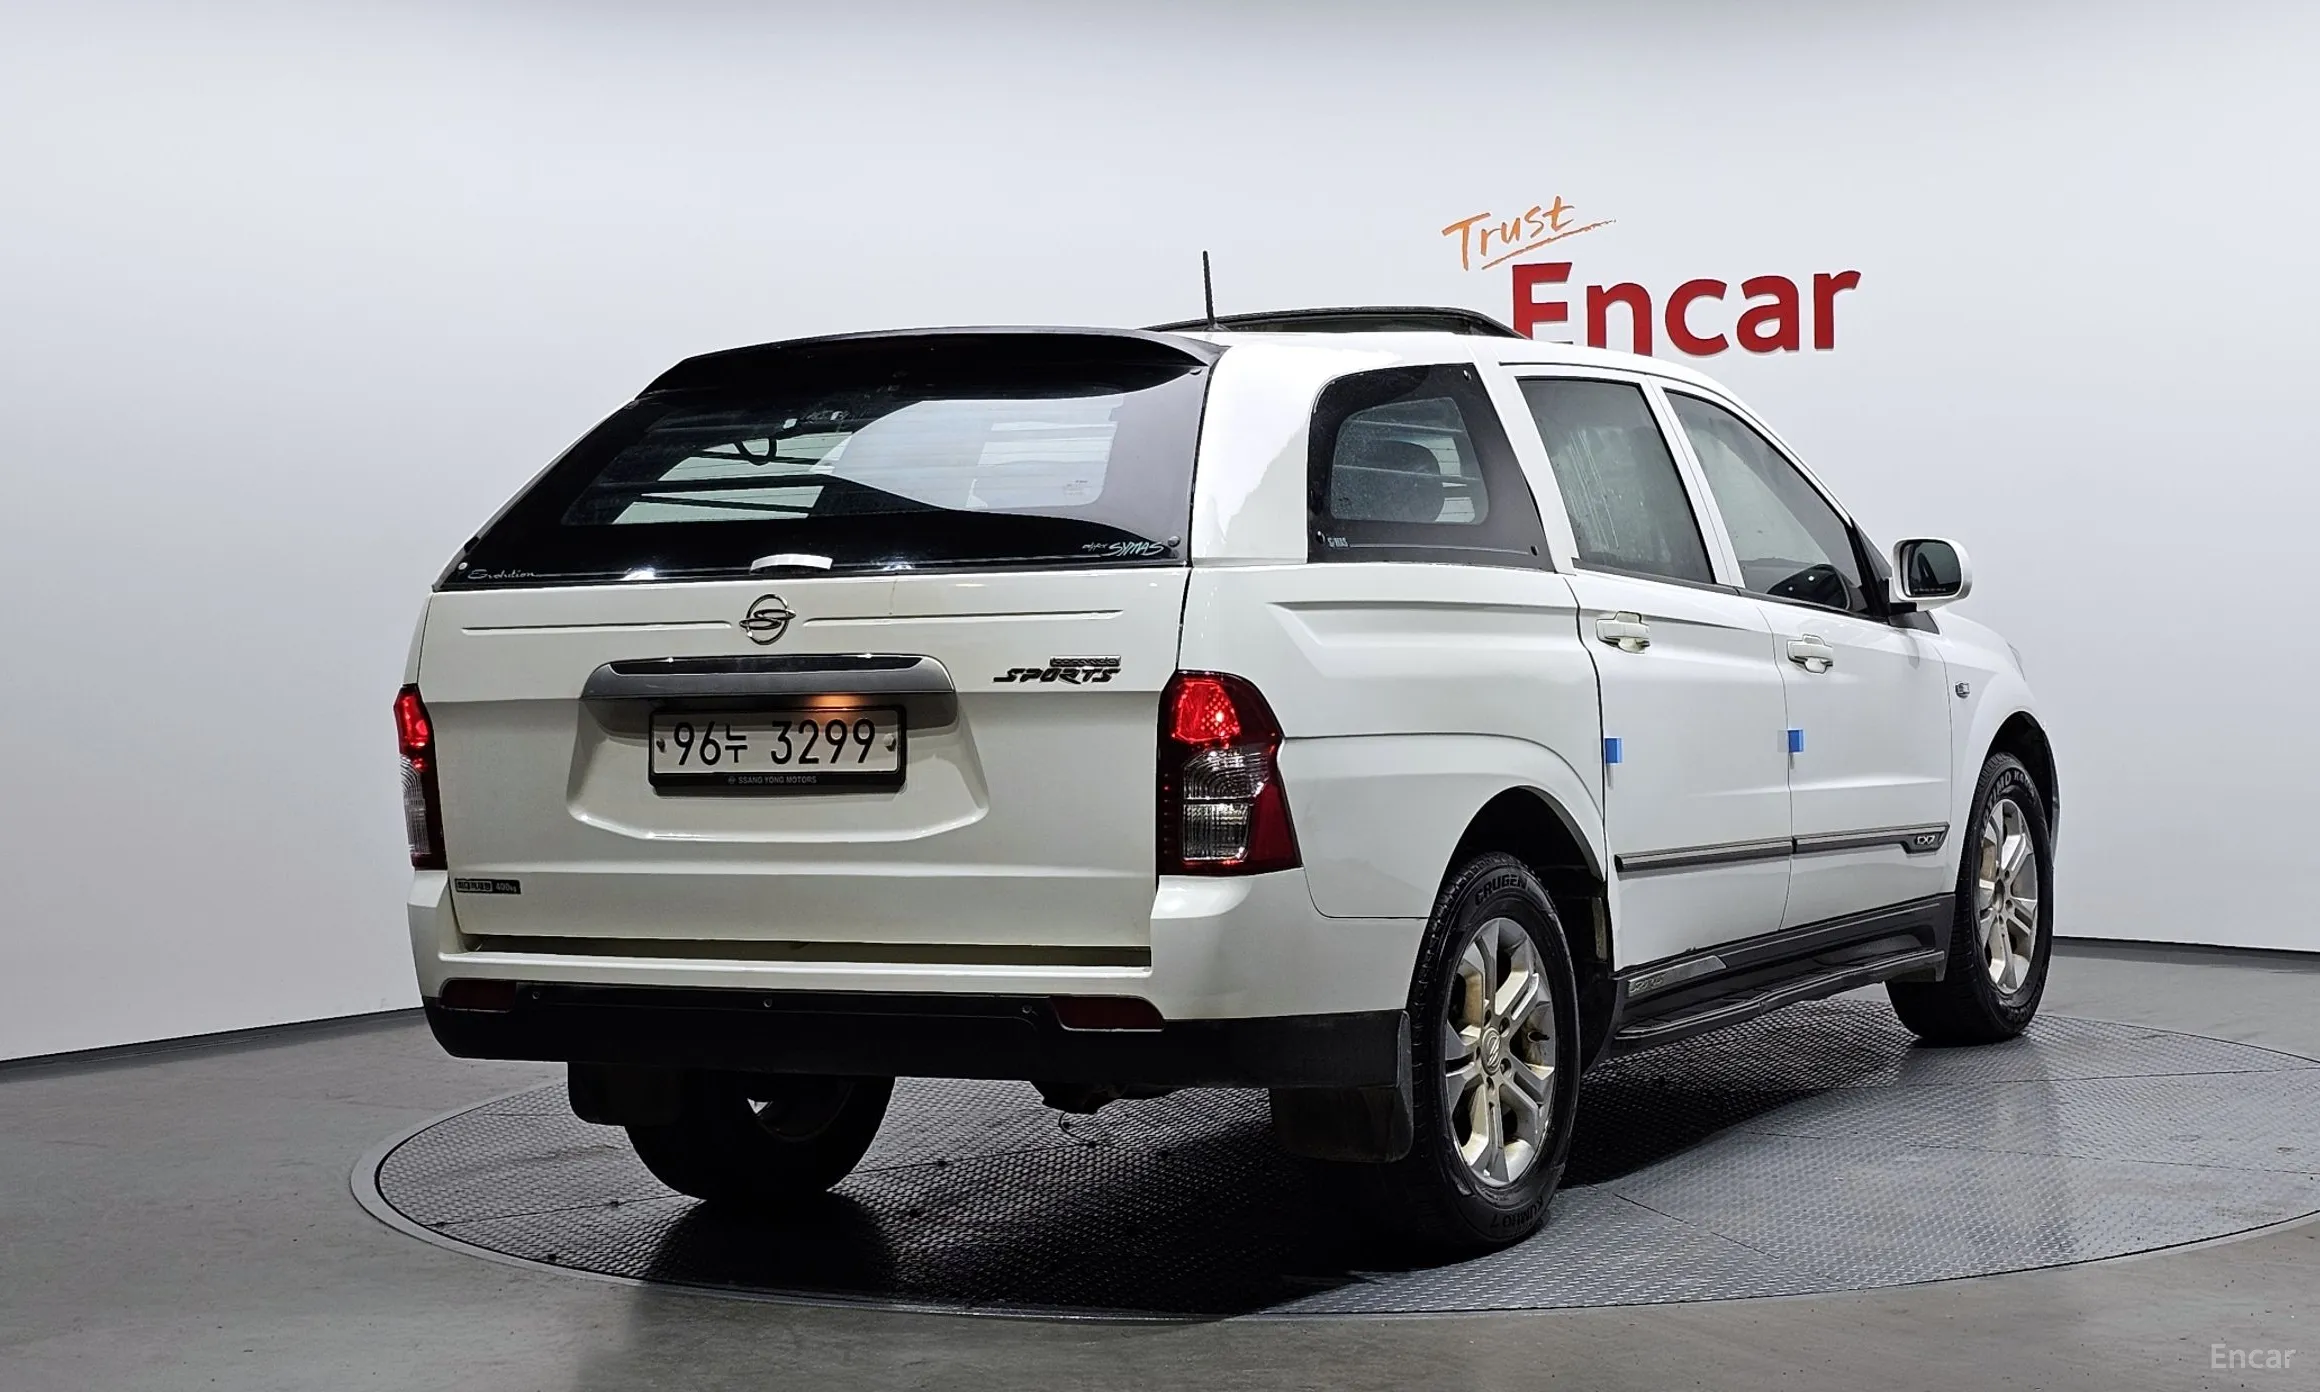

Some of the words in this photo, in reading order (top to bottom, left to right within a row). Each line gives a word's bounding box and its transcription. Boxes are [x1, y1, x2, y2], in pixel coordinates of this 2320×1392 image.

[1441, 196, 1575, 271] Trust
[1511, 261, 1862, 358] Encar
[993, 667, 1121, 684] SPORTS
[673, 719, 748, 766] 96누
[770, 718, 876, 765] 3299
[786, 775, 817, 784] MOTORS
[1474, 873, 1528, 906] CRUGEN
